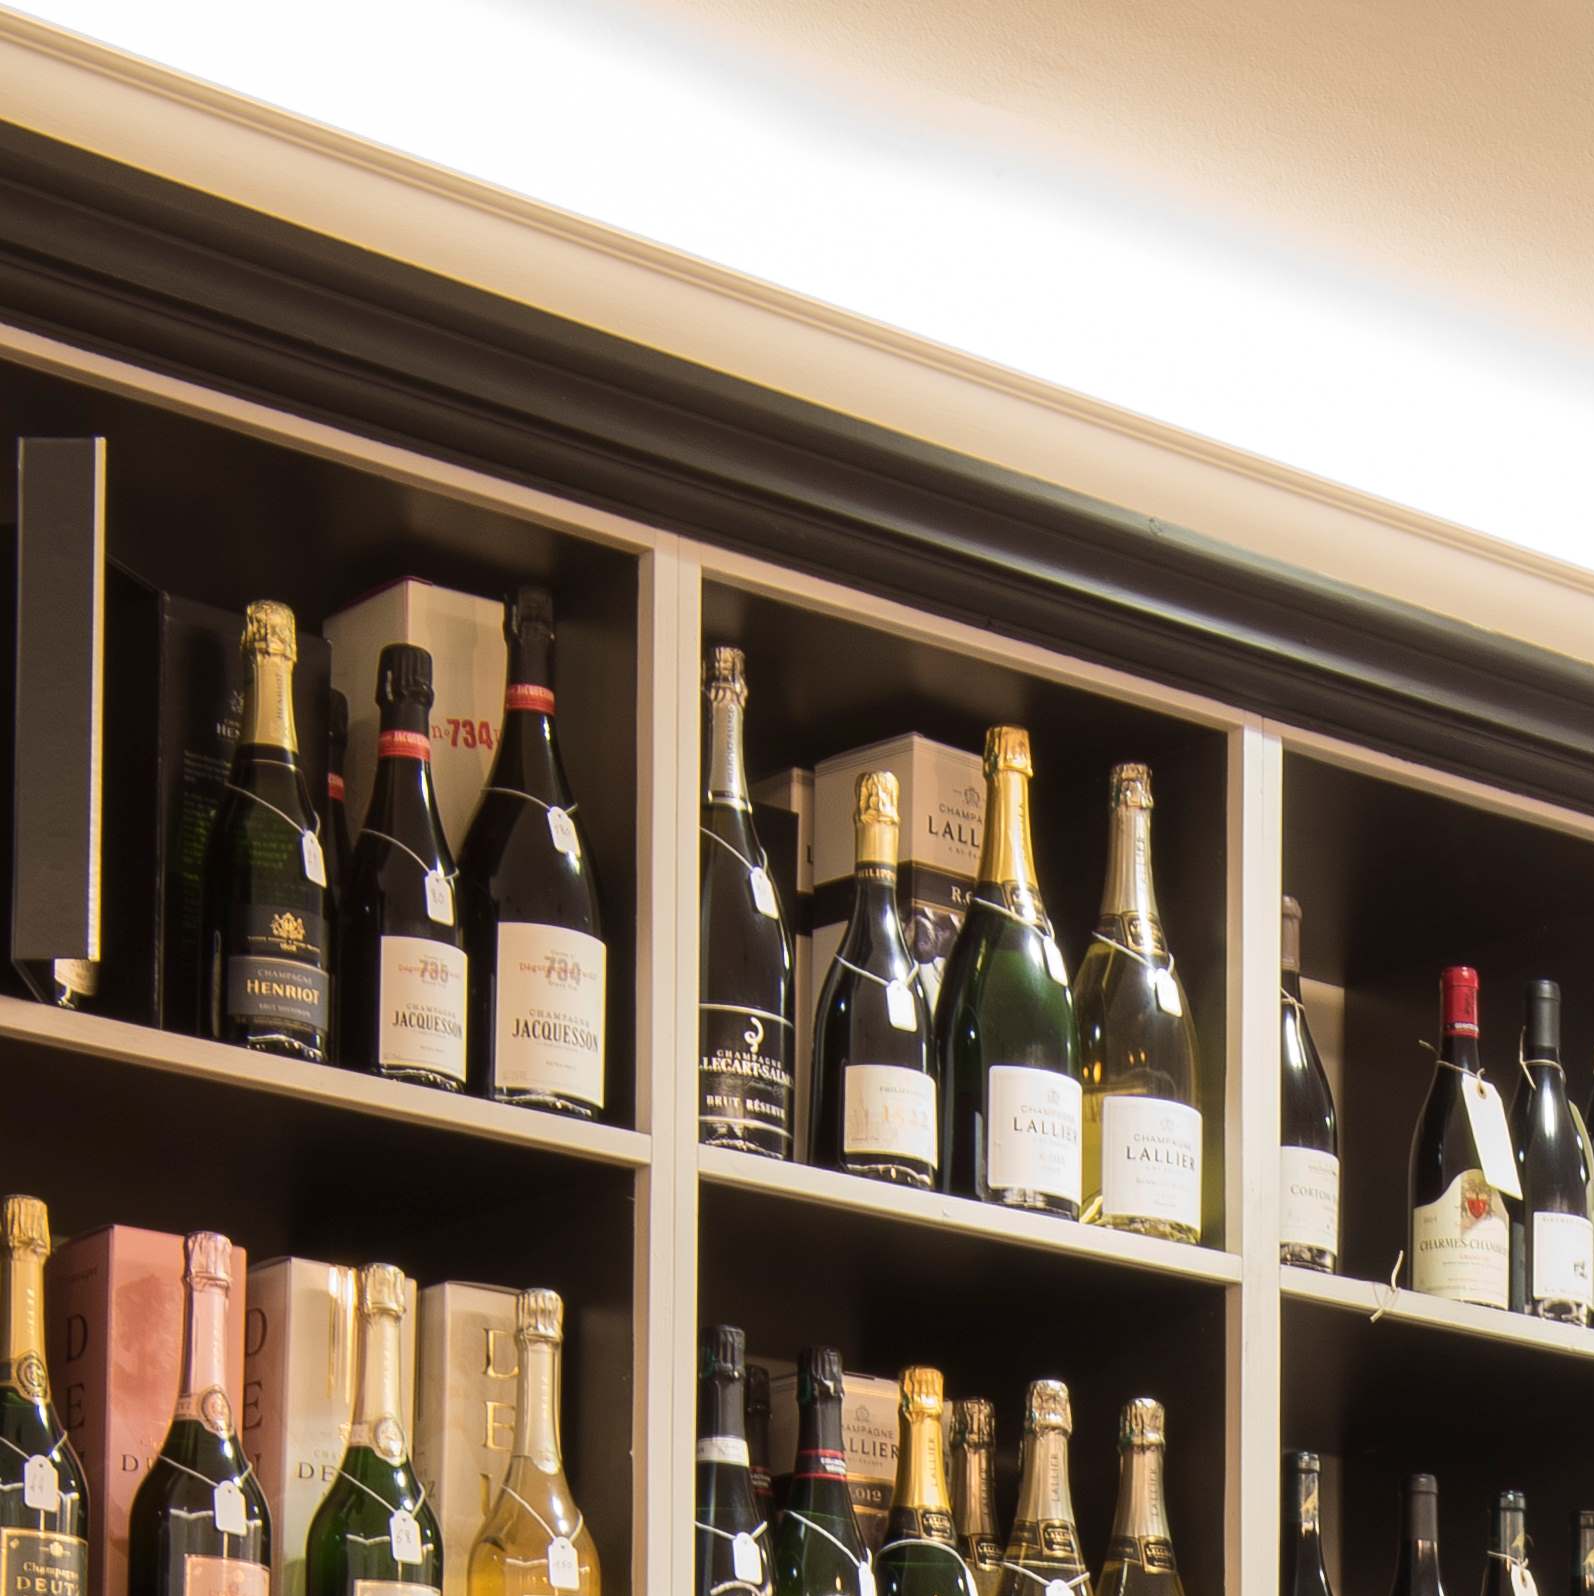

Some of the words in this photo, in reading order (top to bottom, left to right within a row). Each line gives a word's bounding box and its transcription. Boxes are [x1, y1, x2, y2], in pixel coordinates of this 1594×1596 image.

[927, 815, 981, 848] LALL
[257, 967, 313, 983] CHAMPAGNE
[246, 978, 320, 1006] HENRIOT
[392, 1010, 463, 1039] JACQUESSON
[405, 1003, 456, 1018] CHAMPAGNE
[529, 1008, 591, 1027] CHAMPAGNE
[511, 1017, 599, 1053] JACQUESSON
[716, 1048, 783, 1069] CHAMPAGNE
[705, 1094, 741, 1111] BRUT
[1012, 1116, 1078, 1145] LALLIER
[1133, 1132, 1193, 1151] CHAMPAGNE
[1125, 1144, 1196, 1172] LALLIER
[927, 1437, 936, 1488] LALLIER
[1051, 1452, 1060, 1502] LALLIER
